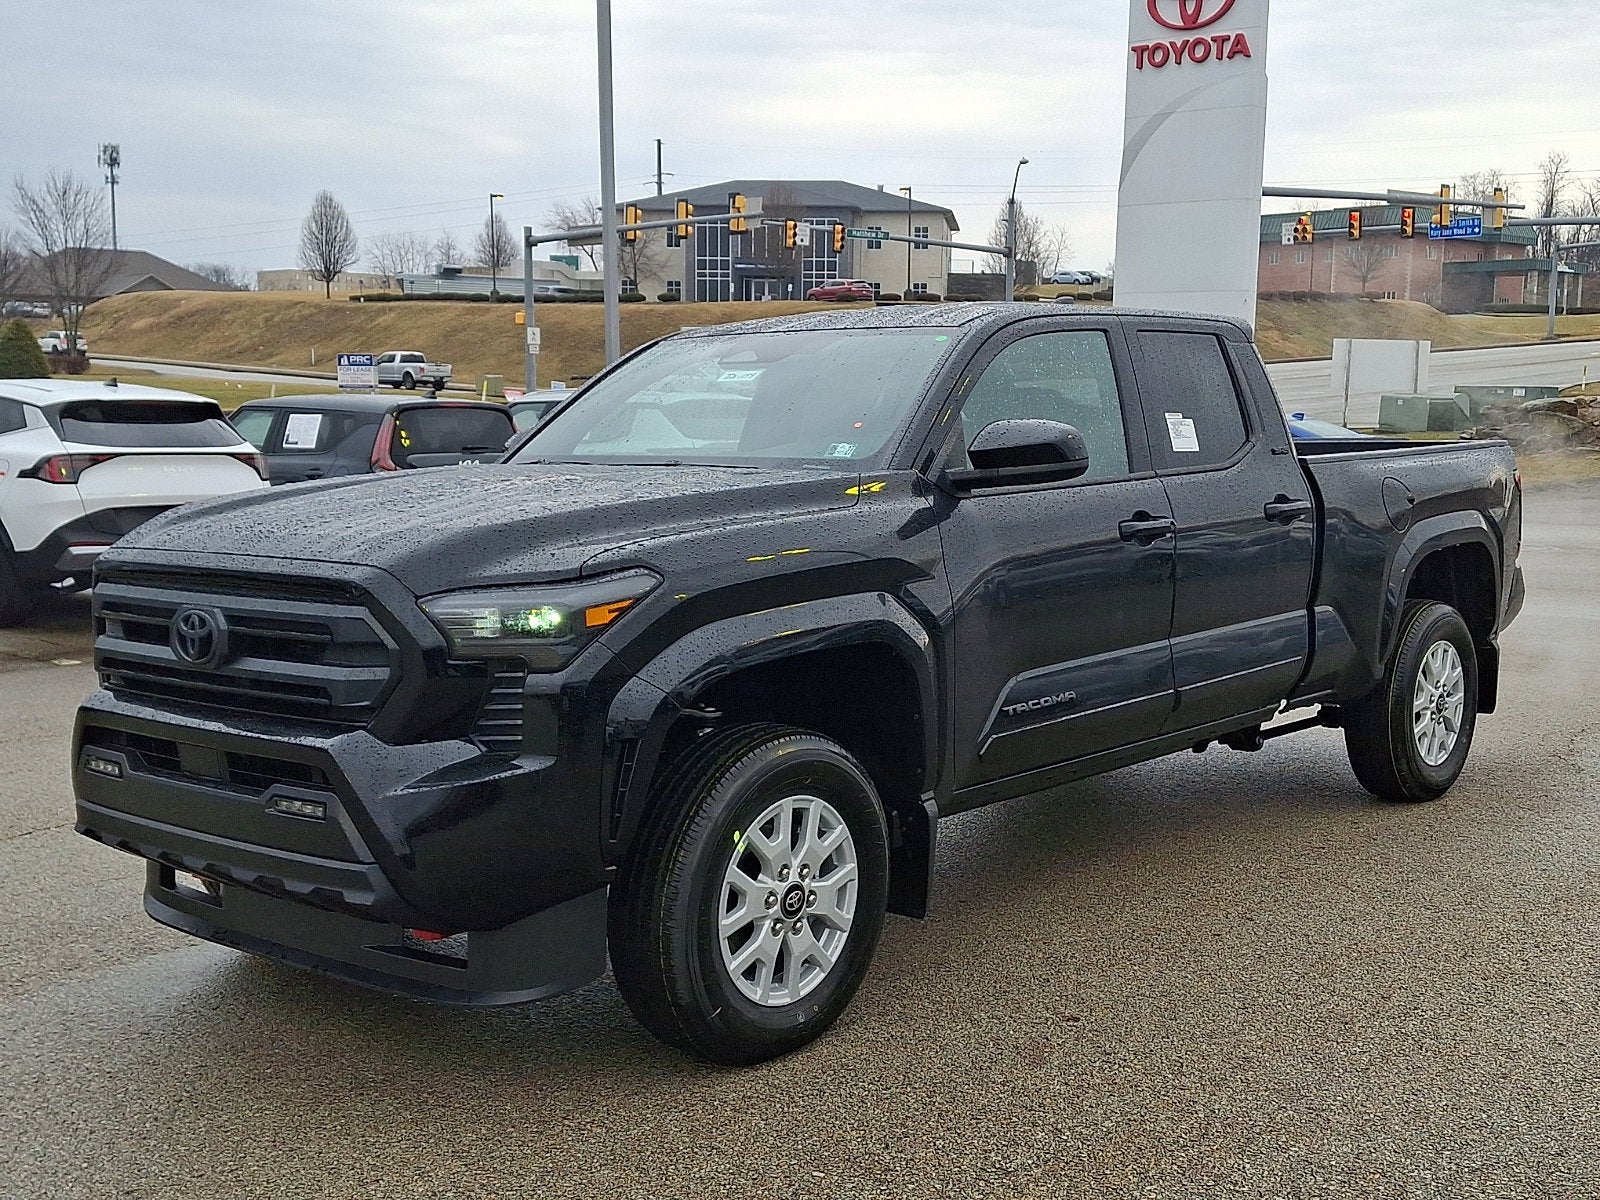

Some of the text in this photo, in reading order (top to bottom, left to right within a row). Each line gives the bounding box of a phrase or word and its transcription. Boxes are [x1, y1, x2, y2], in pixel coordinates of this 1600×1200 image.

[1131, 33, 1251, 70] TOYOTA
[852, 230, 877, 238] Matthew
[1453, 227, 1466, 235] Wood
[349, 355, 371, 363] PRC
[1001, 691, 1077, 716] TACOMA
